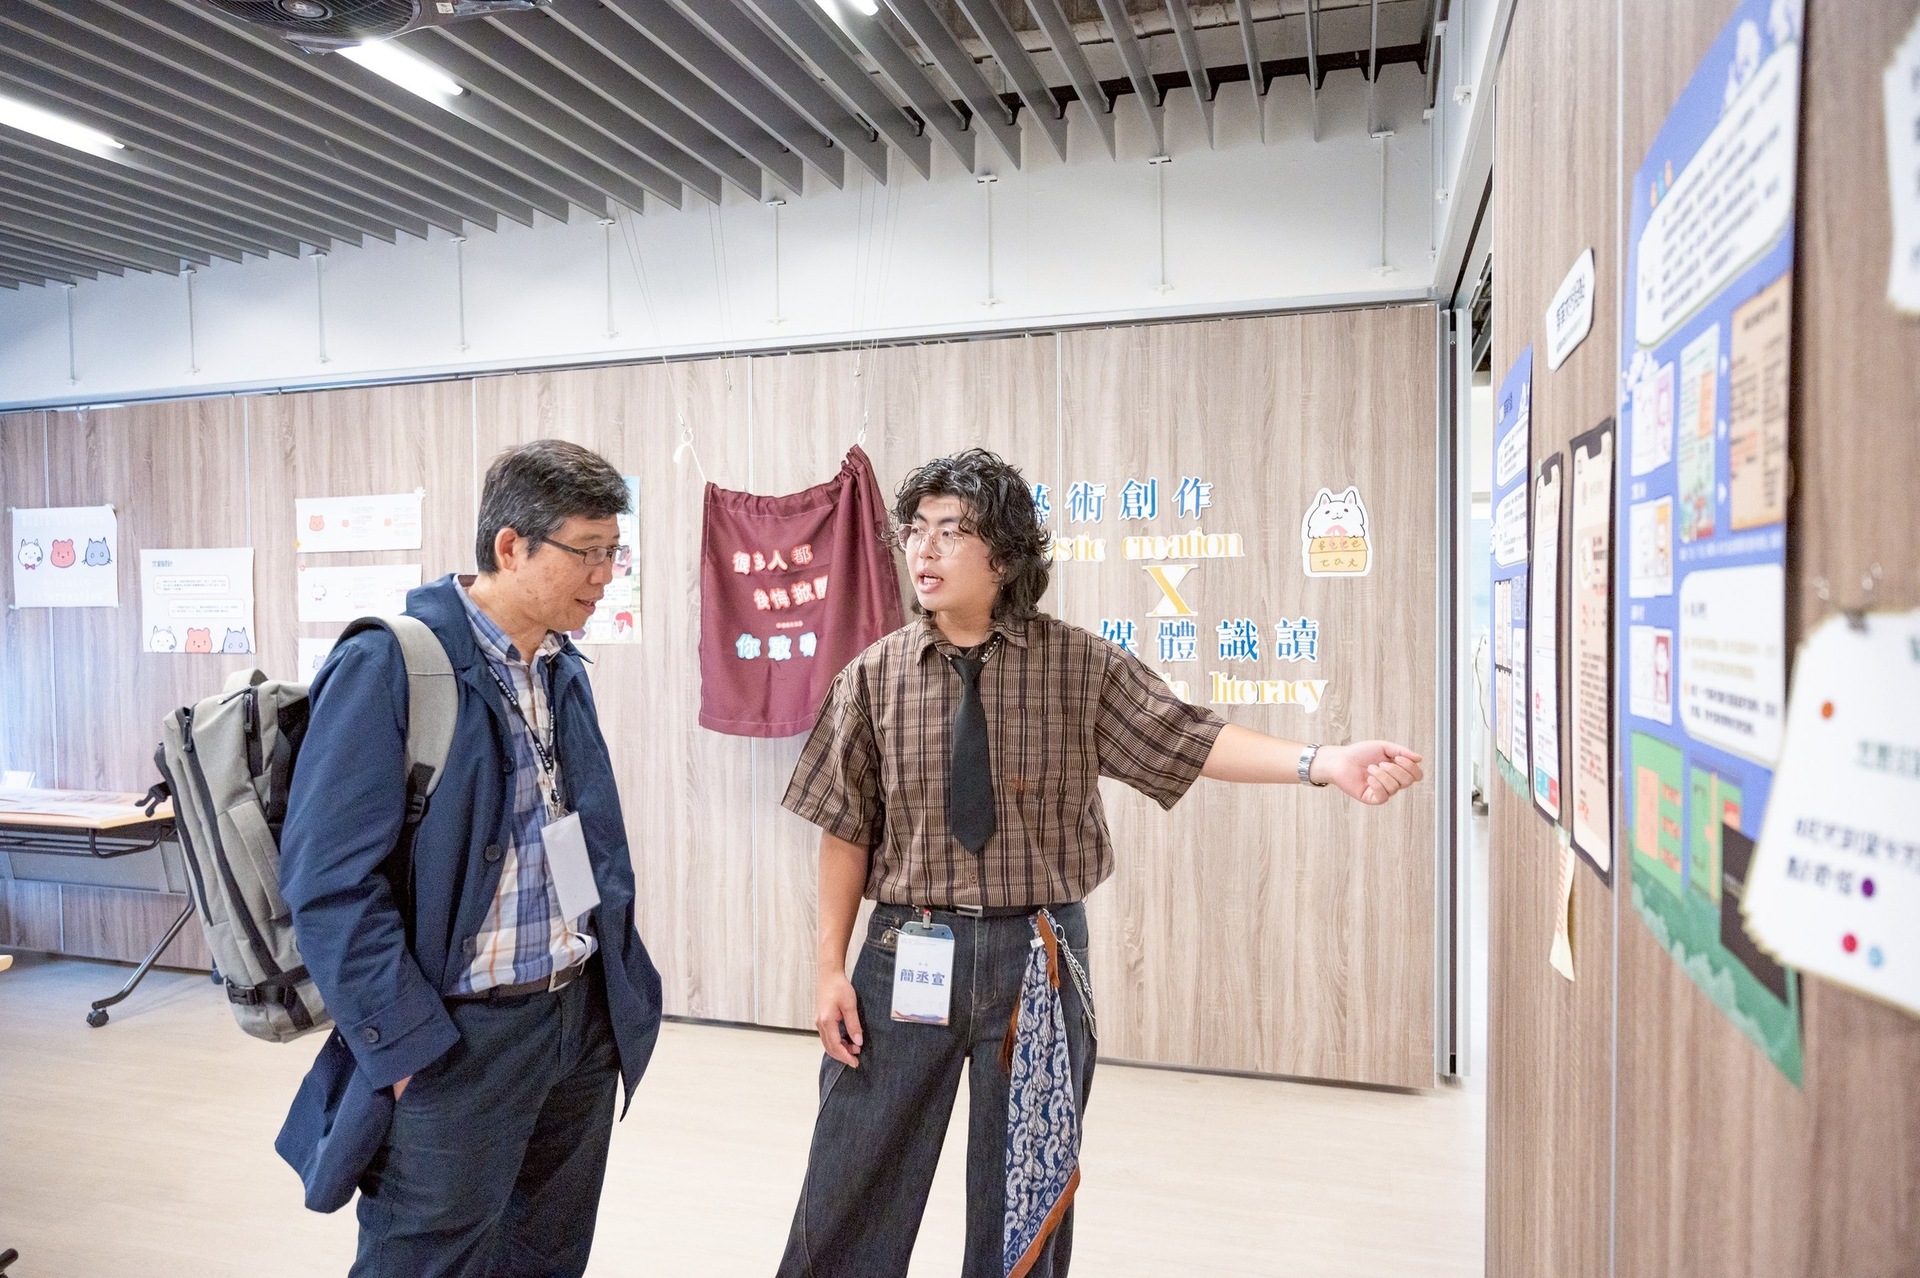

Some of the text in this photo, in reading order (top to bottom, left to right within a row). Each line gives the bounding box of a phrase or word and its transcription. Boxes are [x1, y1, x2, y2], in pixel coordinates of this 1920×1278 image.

[1121, 527, 1244, 560] creation
[1100, 618, 1319, 662] 媒體識讀
[1209, 671, 1327, 713] literacy
